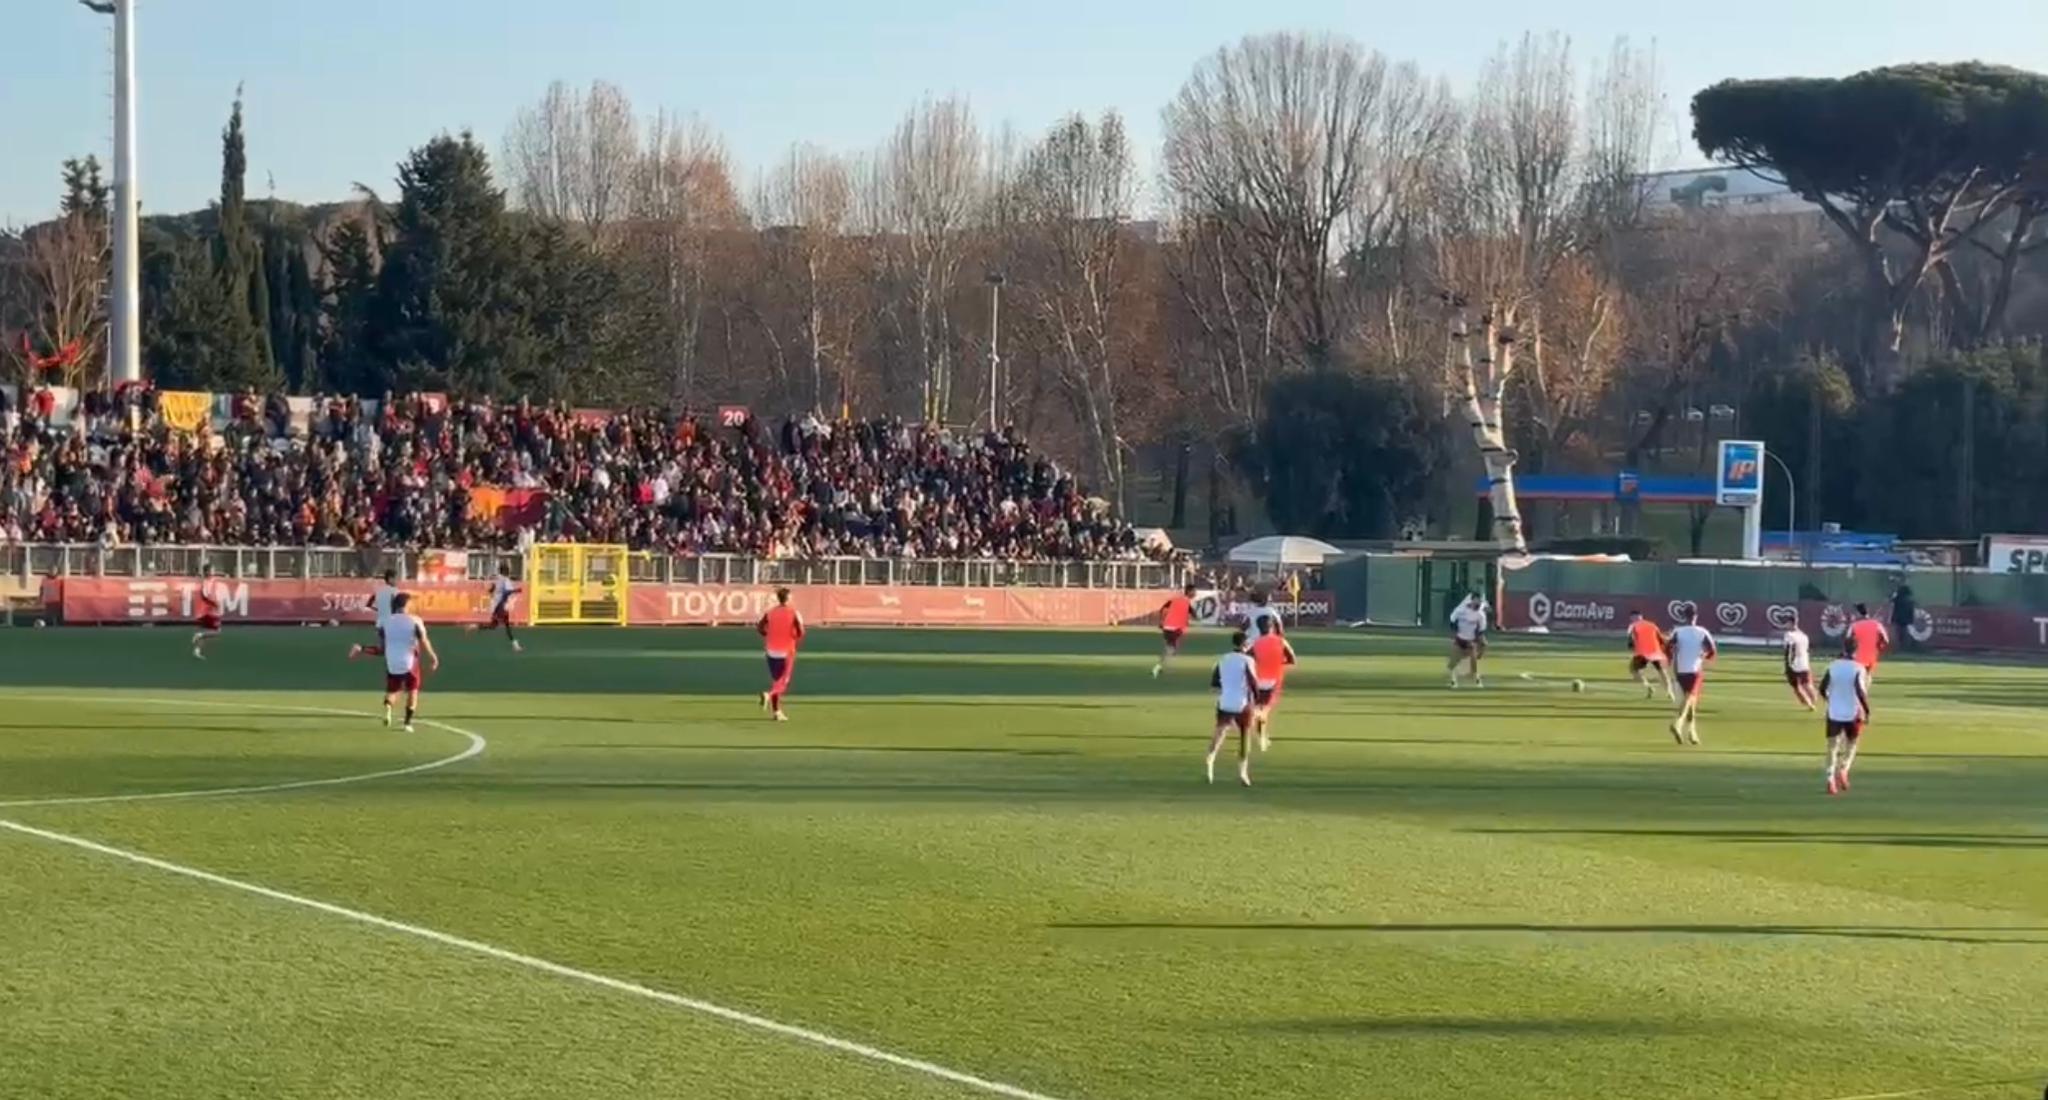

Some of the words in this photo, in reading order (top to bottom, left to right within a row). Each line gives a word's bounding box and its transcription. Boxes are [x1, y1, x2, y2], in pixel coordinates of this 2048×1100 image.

[723, 410, 745, 427] 20
[1728, 460, 1757, 480] IP
[2007, 549, 2048, 573] SP
[174, 582, 249, 616] TM
[1554, 600, 1615, 620] ComAve
